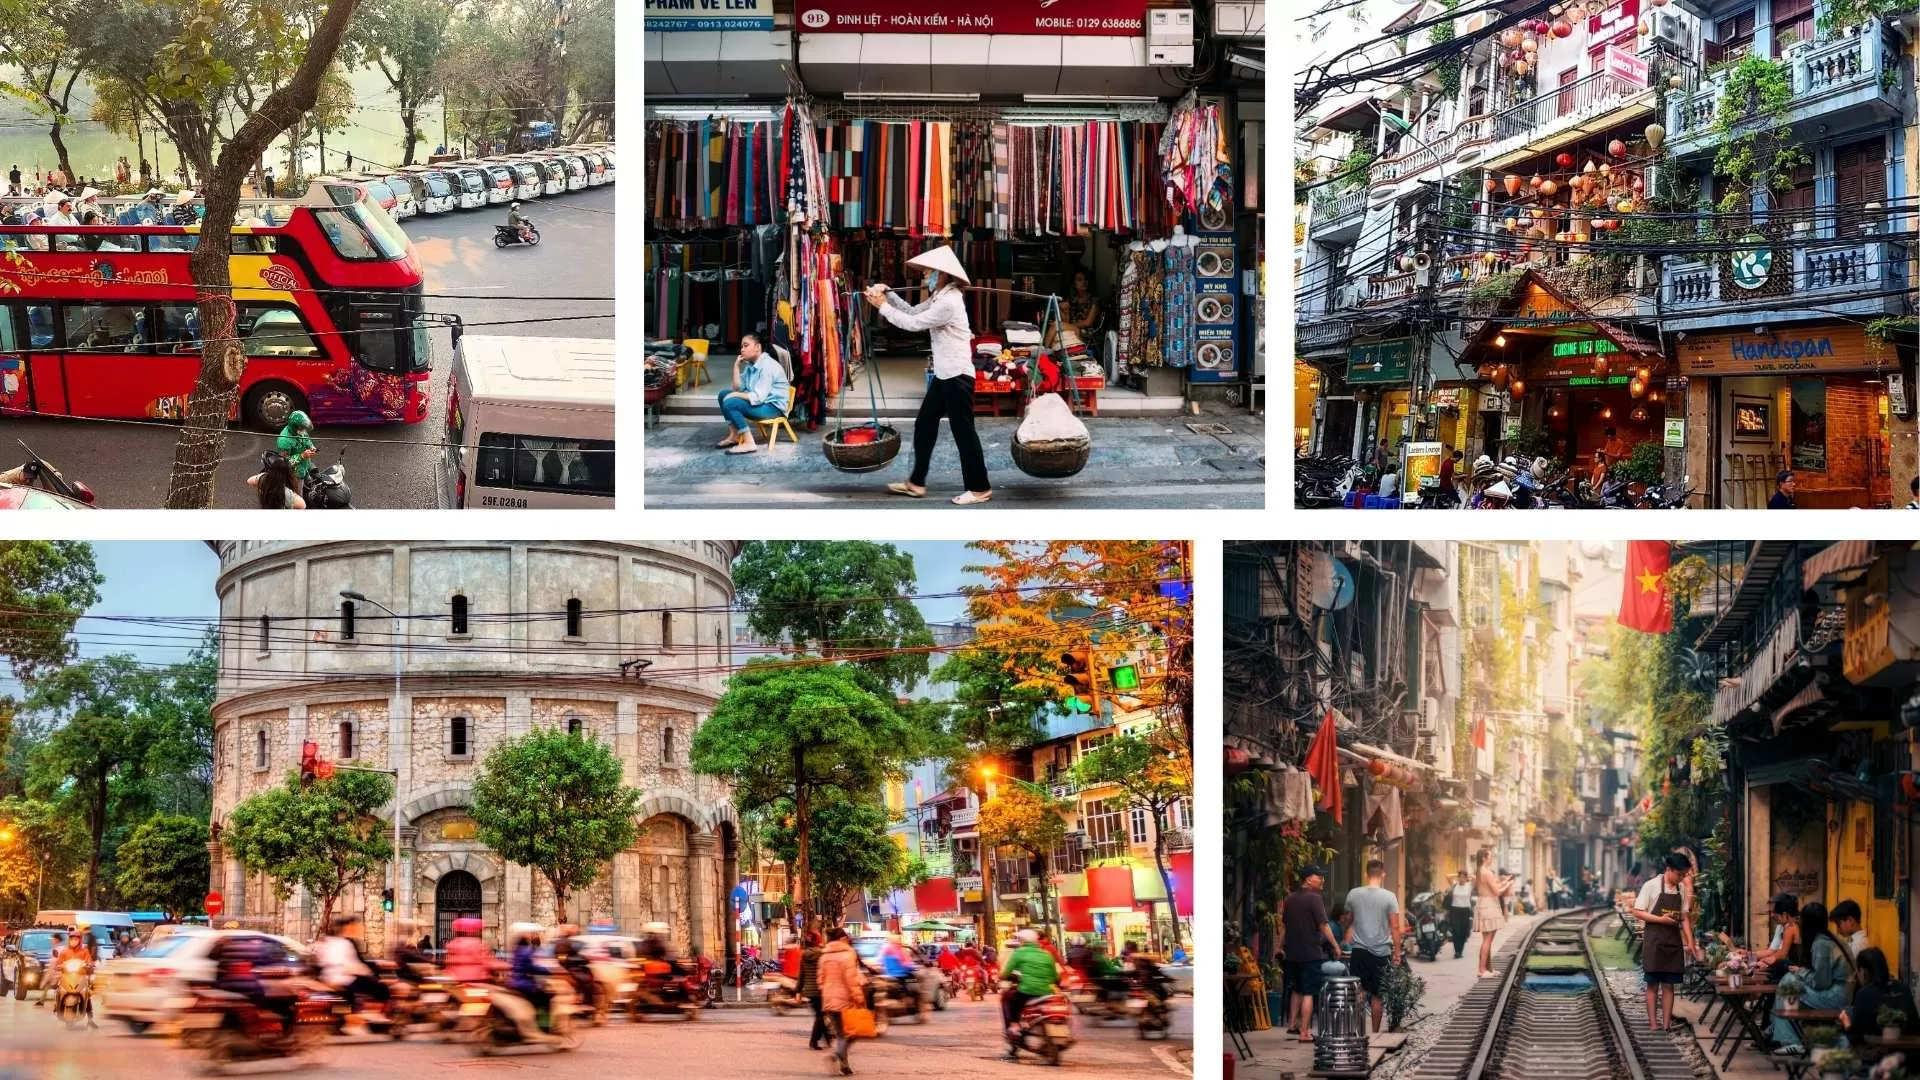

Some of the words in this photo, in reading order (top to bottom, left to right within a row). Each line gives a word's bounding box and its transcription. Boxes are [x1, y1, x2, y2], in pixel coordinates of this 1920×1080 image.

[807, 13, 825, 23] 9B
[837, 15, 861, 25] ĐINH
[864, 13, 881, 27] LIỆT
[891, 13, 921, 25] HOÀN
[924, 12, 947, 25] KIẾM
[958, 13, 972, 26] HÀ
[975, 14, 994, 28] NỘI
[1036, 18, 1074, 28] MOBILE:
[1077, 18, 1100, 28] 0129
[1102, 19, 1142, 29] 6386886
[263, 270, 297, 288] OFFICIAL
[1554, 342, 1577, 357] CUISINE
[1731, 335, 1833, 363] Handspan
[1608, 376, 1628, 384] CENTER
[1426, 445, 1441, 454] Lounge
